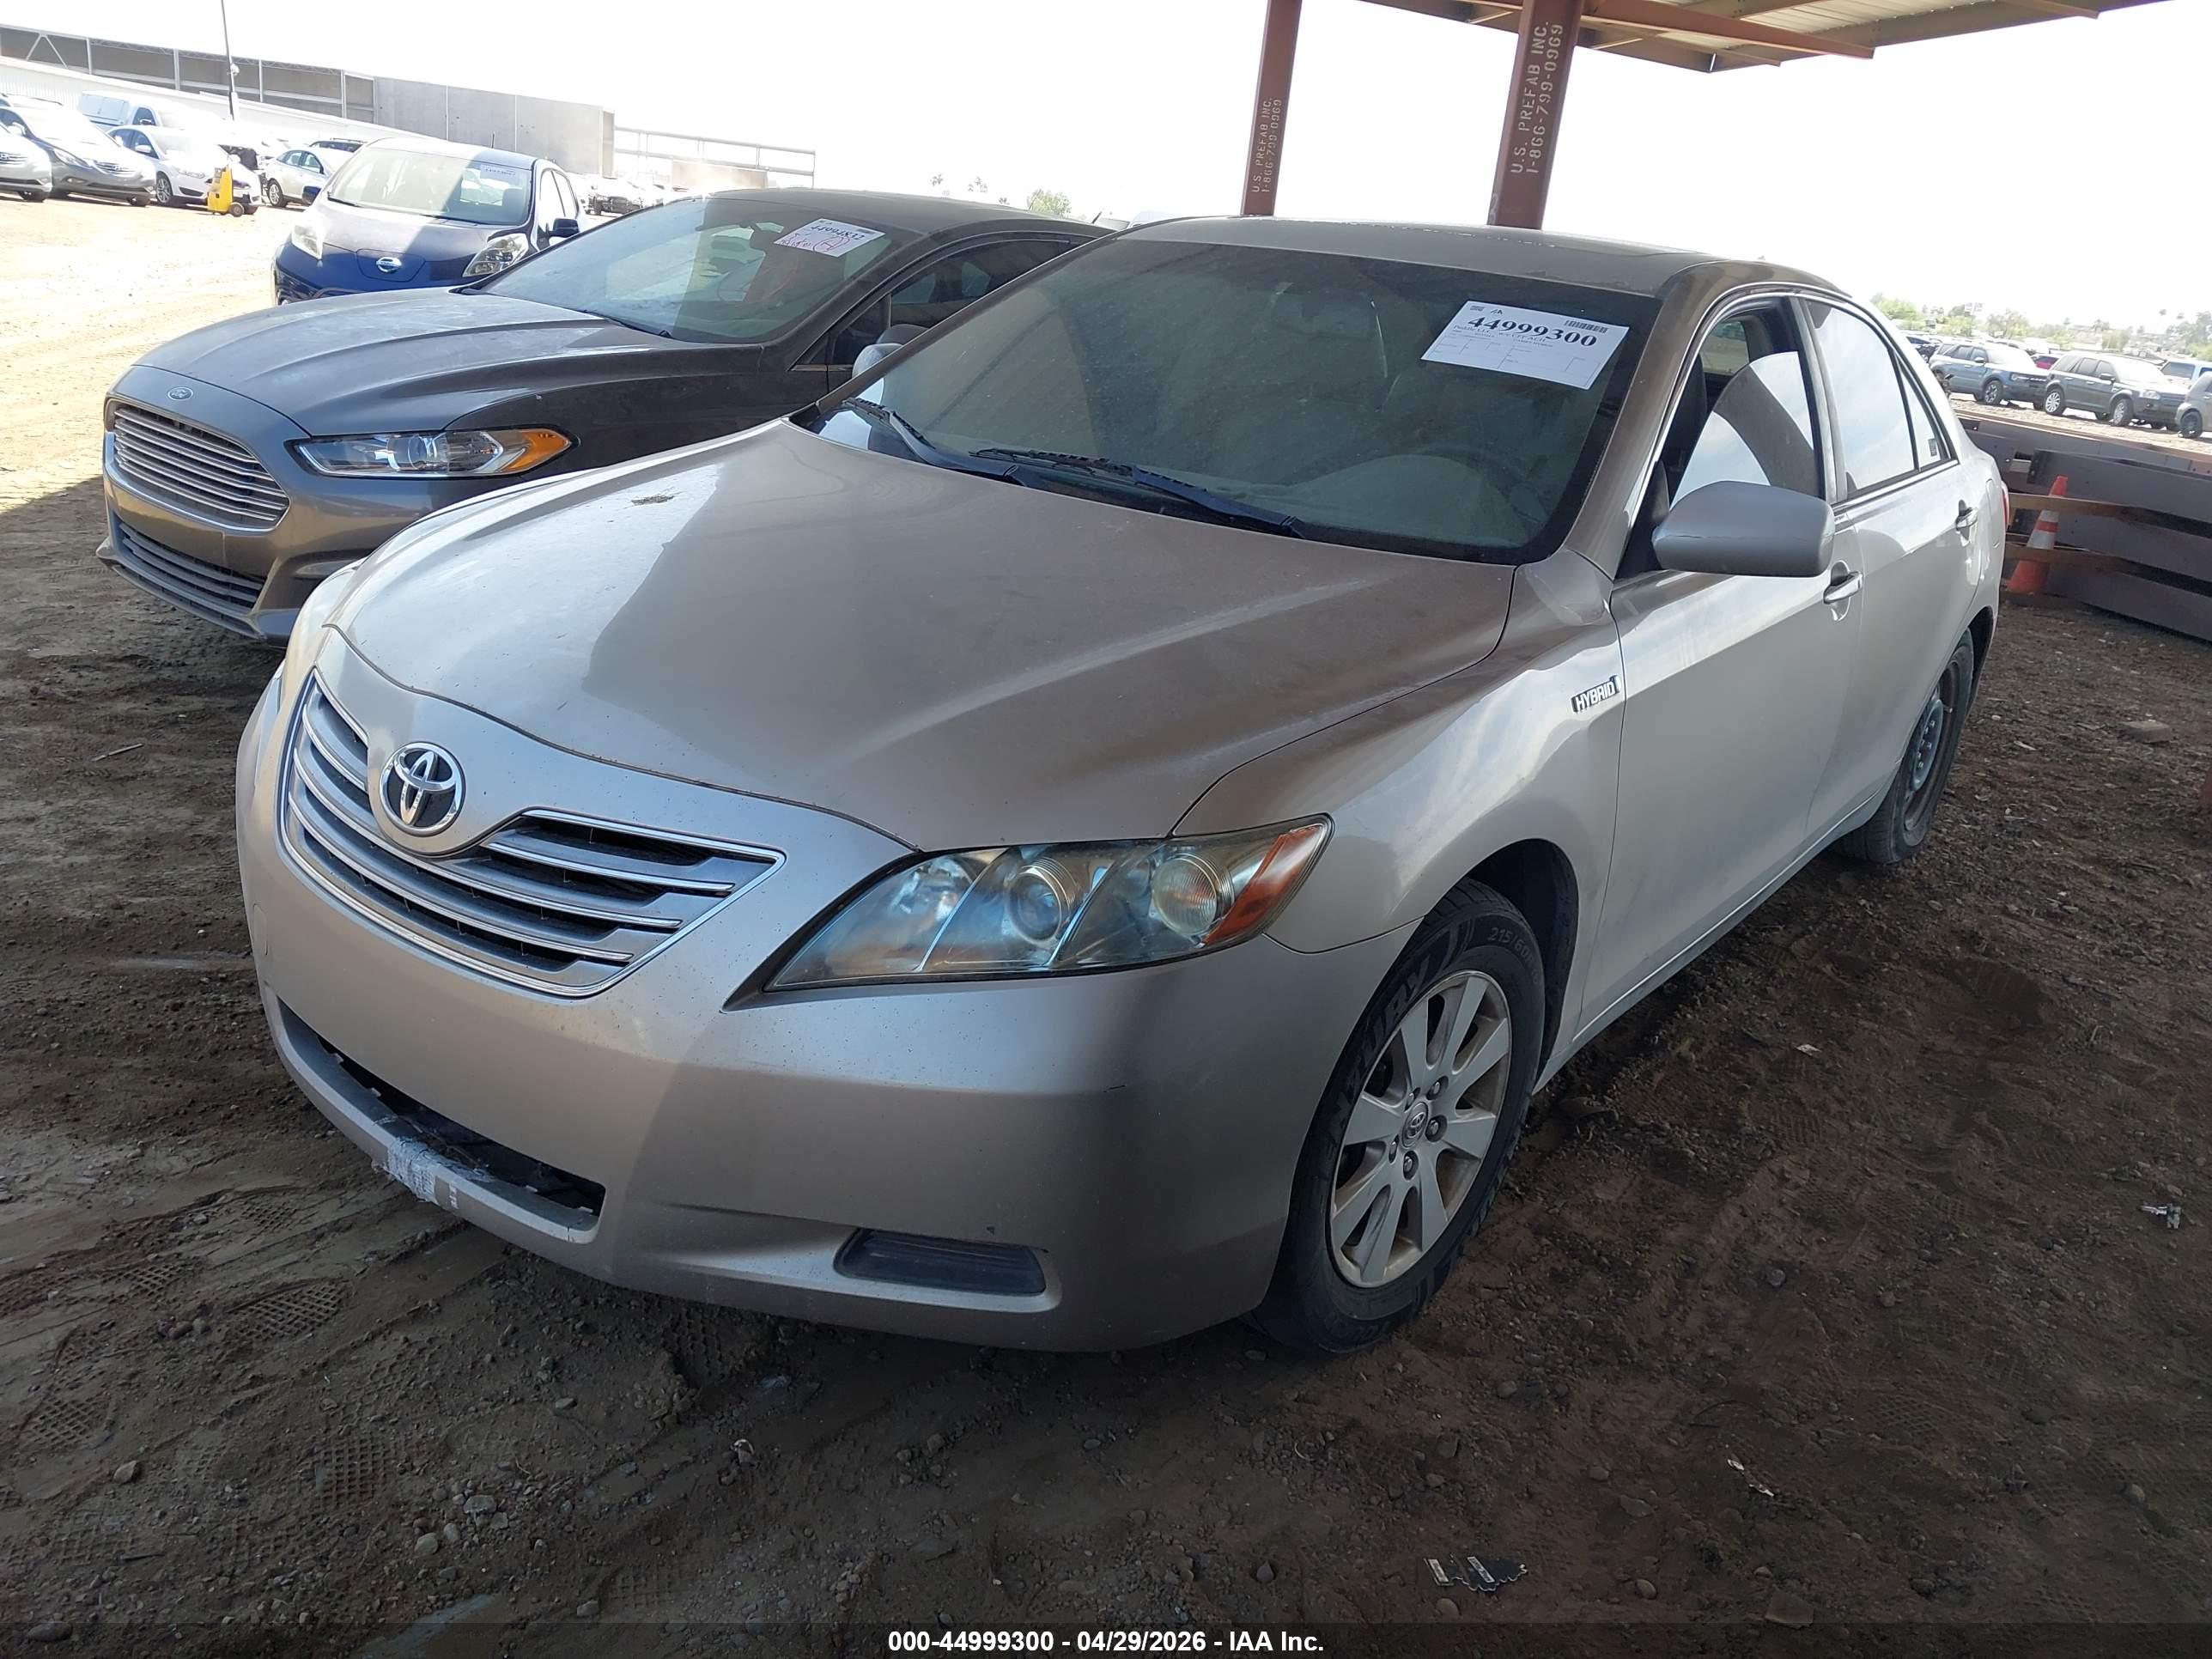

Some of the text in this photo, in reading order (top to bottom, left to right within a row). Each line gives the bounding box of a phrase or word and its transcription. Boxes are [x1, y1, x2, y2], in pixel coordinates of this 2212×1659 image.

[1251, 97, 1273, 192] U.S. PREFAB INC.
[1510, 21, 1549, 174] U.S. PREFAB INC.
[1526, 24, 1564, 173] 1-866-799-0969
[1468, 316, 1597, 347] 44999300
[1575, 681, 1616, 709] HYBRID
